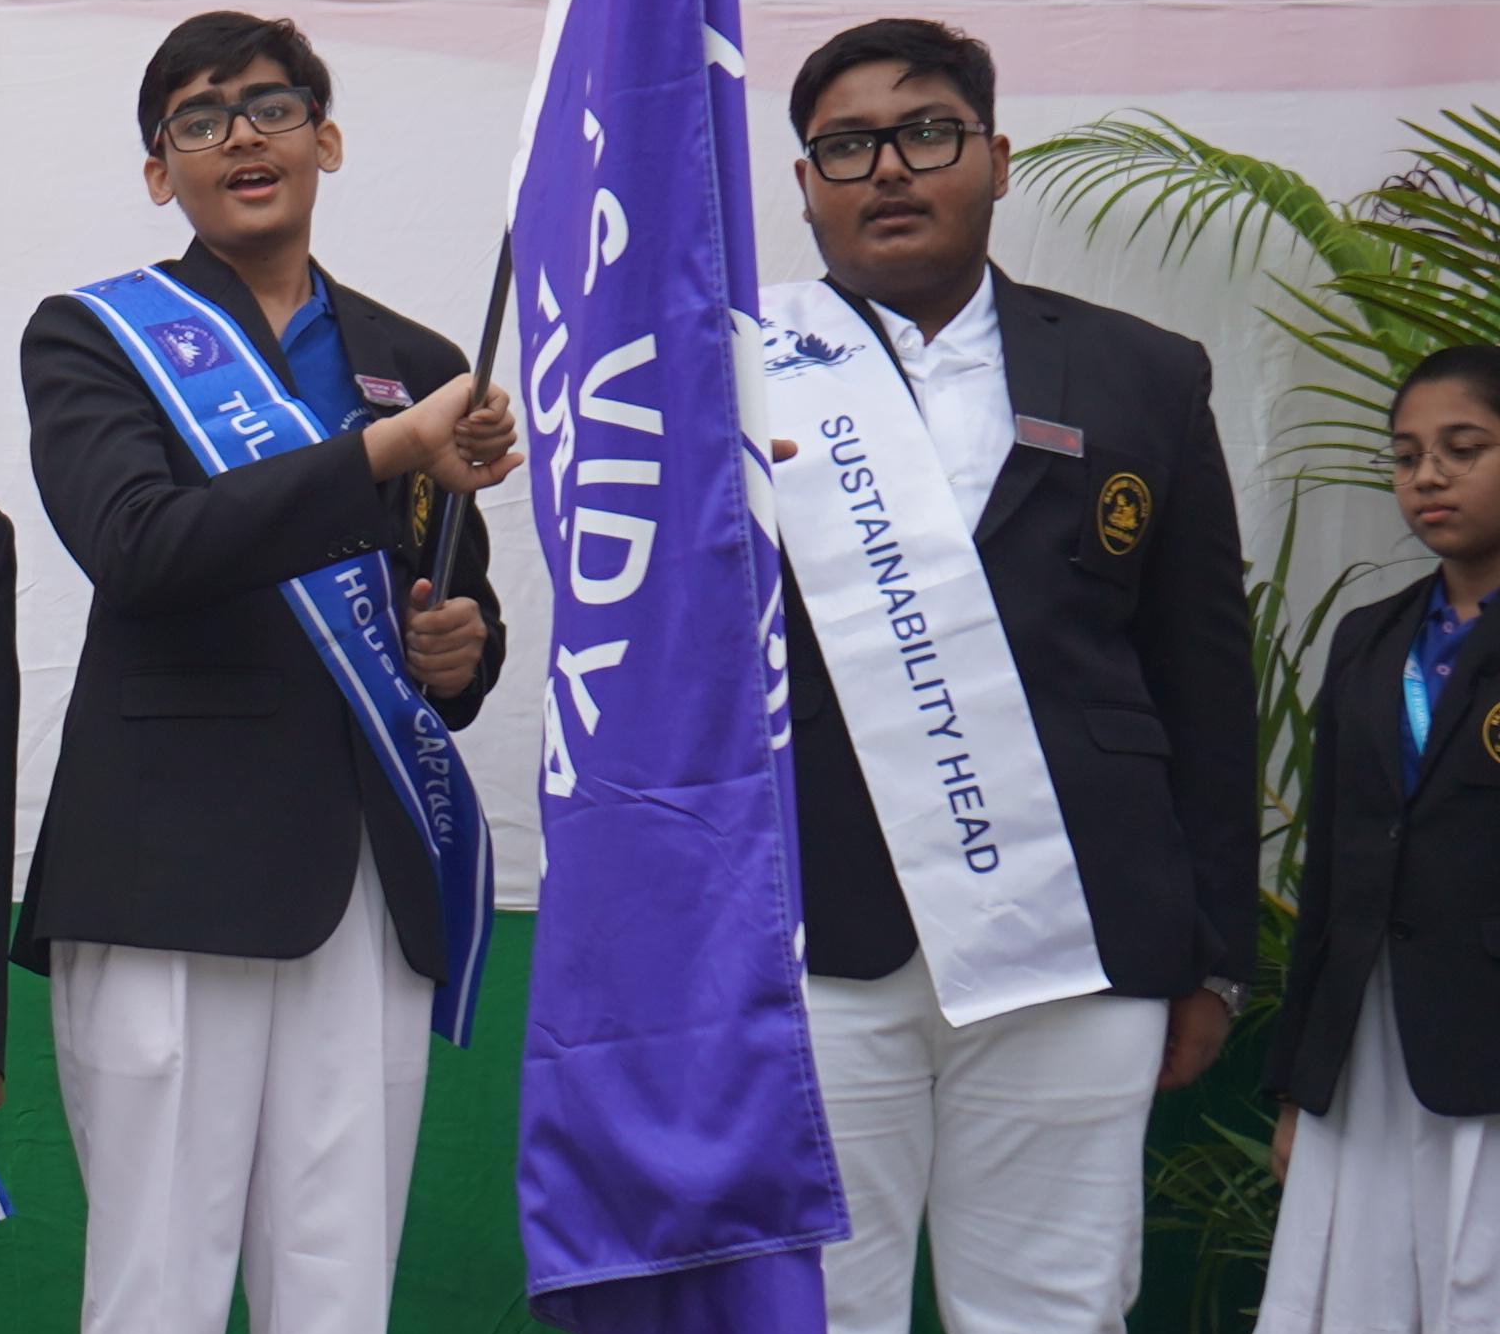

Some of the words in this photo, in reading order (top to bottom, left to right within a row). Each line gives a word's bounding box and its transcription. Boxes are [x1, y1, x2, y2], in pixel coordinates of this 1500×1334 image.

[335, 567, 416, 701] HOUSE
[821, 414, 964, 739] SUSTAINABILITY
[937, 753, 1002, 876] HEAD
